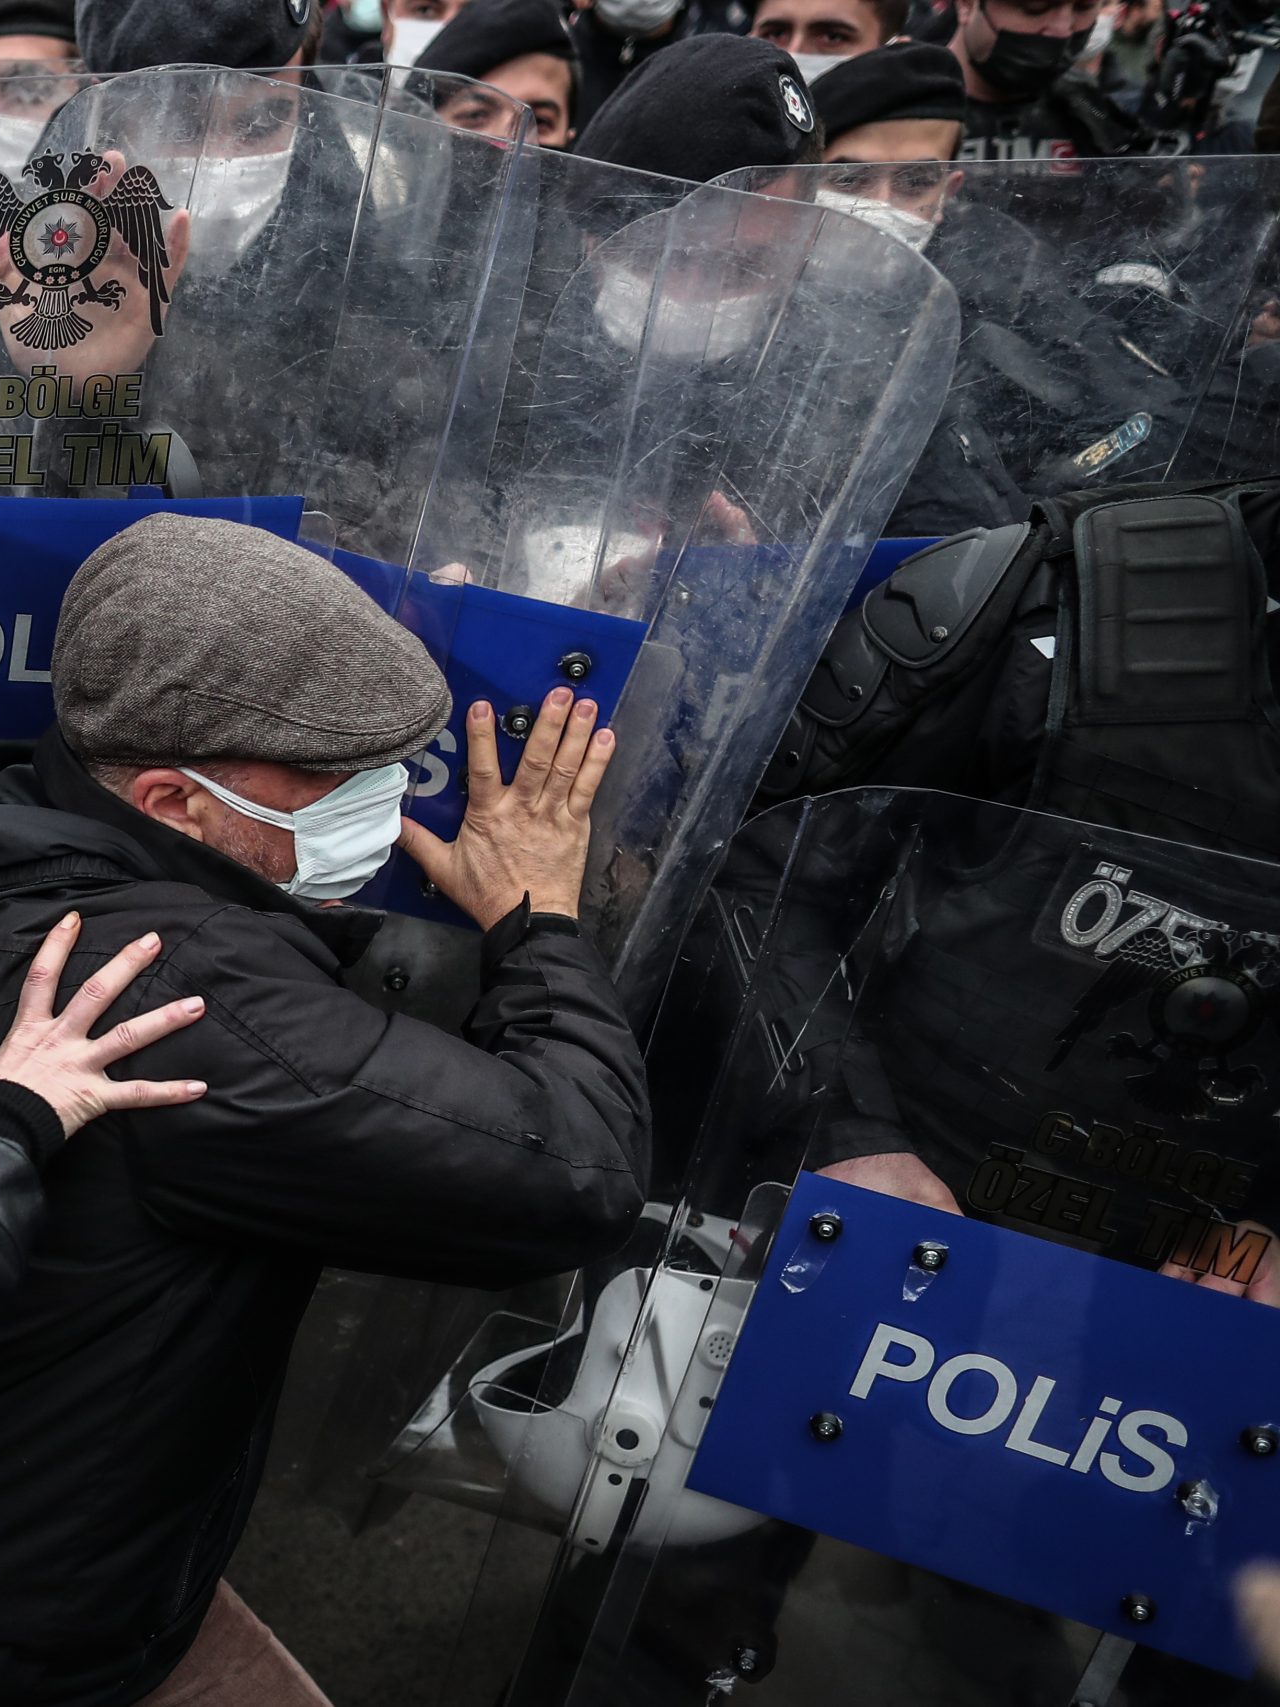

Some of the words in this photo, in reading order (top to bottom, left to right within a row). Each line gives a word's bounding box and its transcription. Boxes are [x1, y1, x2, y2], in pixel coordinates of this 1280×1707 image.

[14, 195, 50, 233] KUVVET
[52, 191, 84, 204] ŞUBE
[48, 266, 66, 274] EGM
[62, 423, 172, 487] TİM
[1077, 1119, 1262, 1210] BÖLGE
[966, 1142, 1120, 1245] ÖZEL
[1135, 1199, 1272, 1286] TİM
